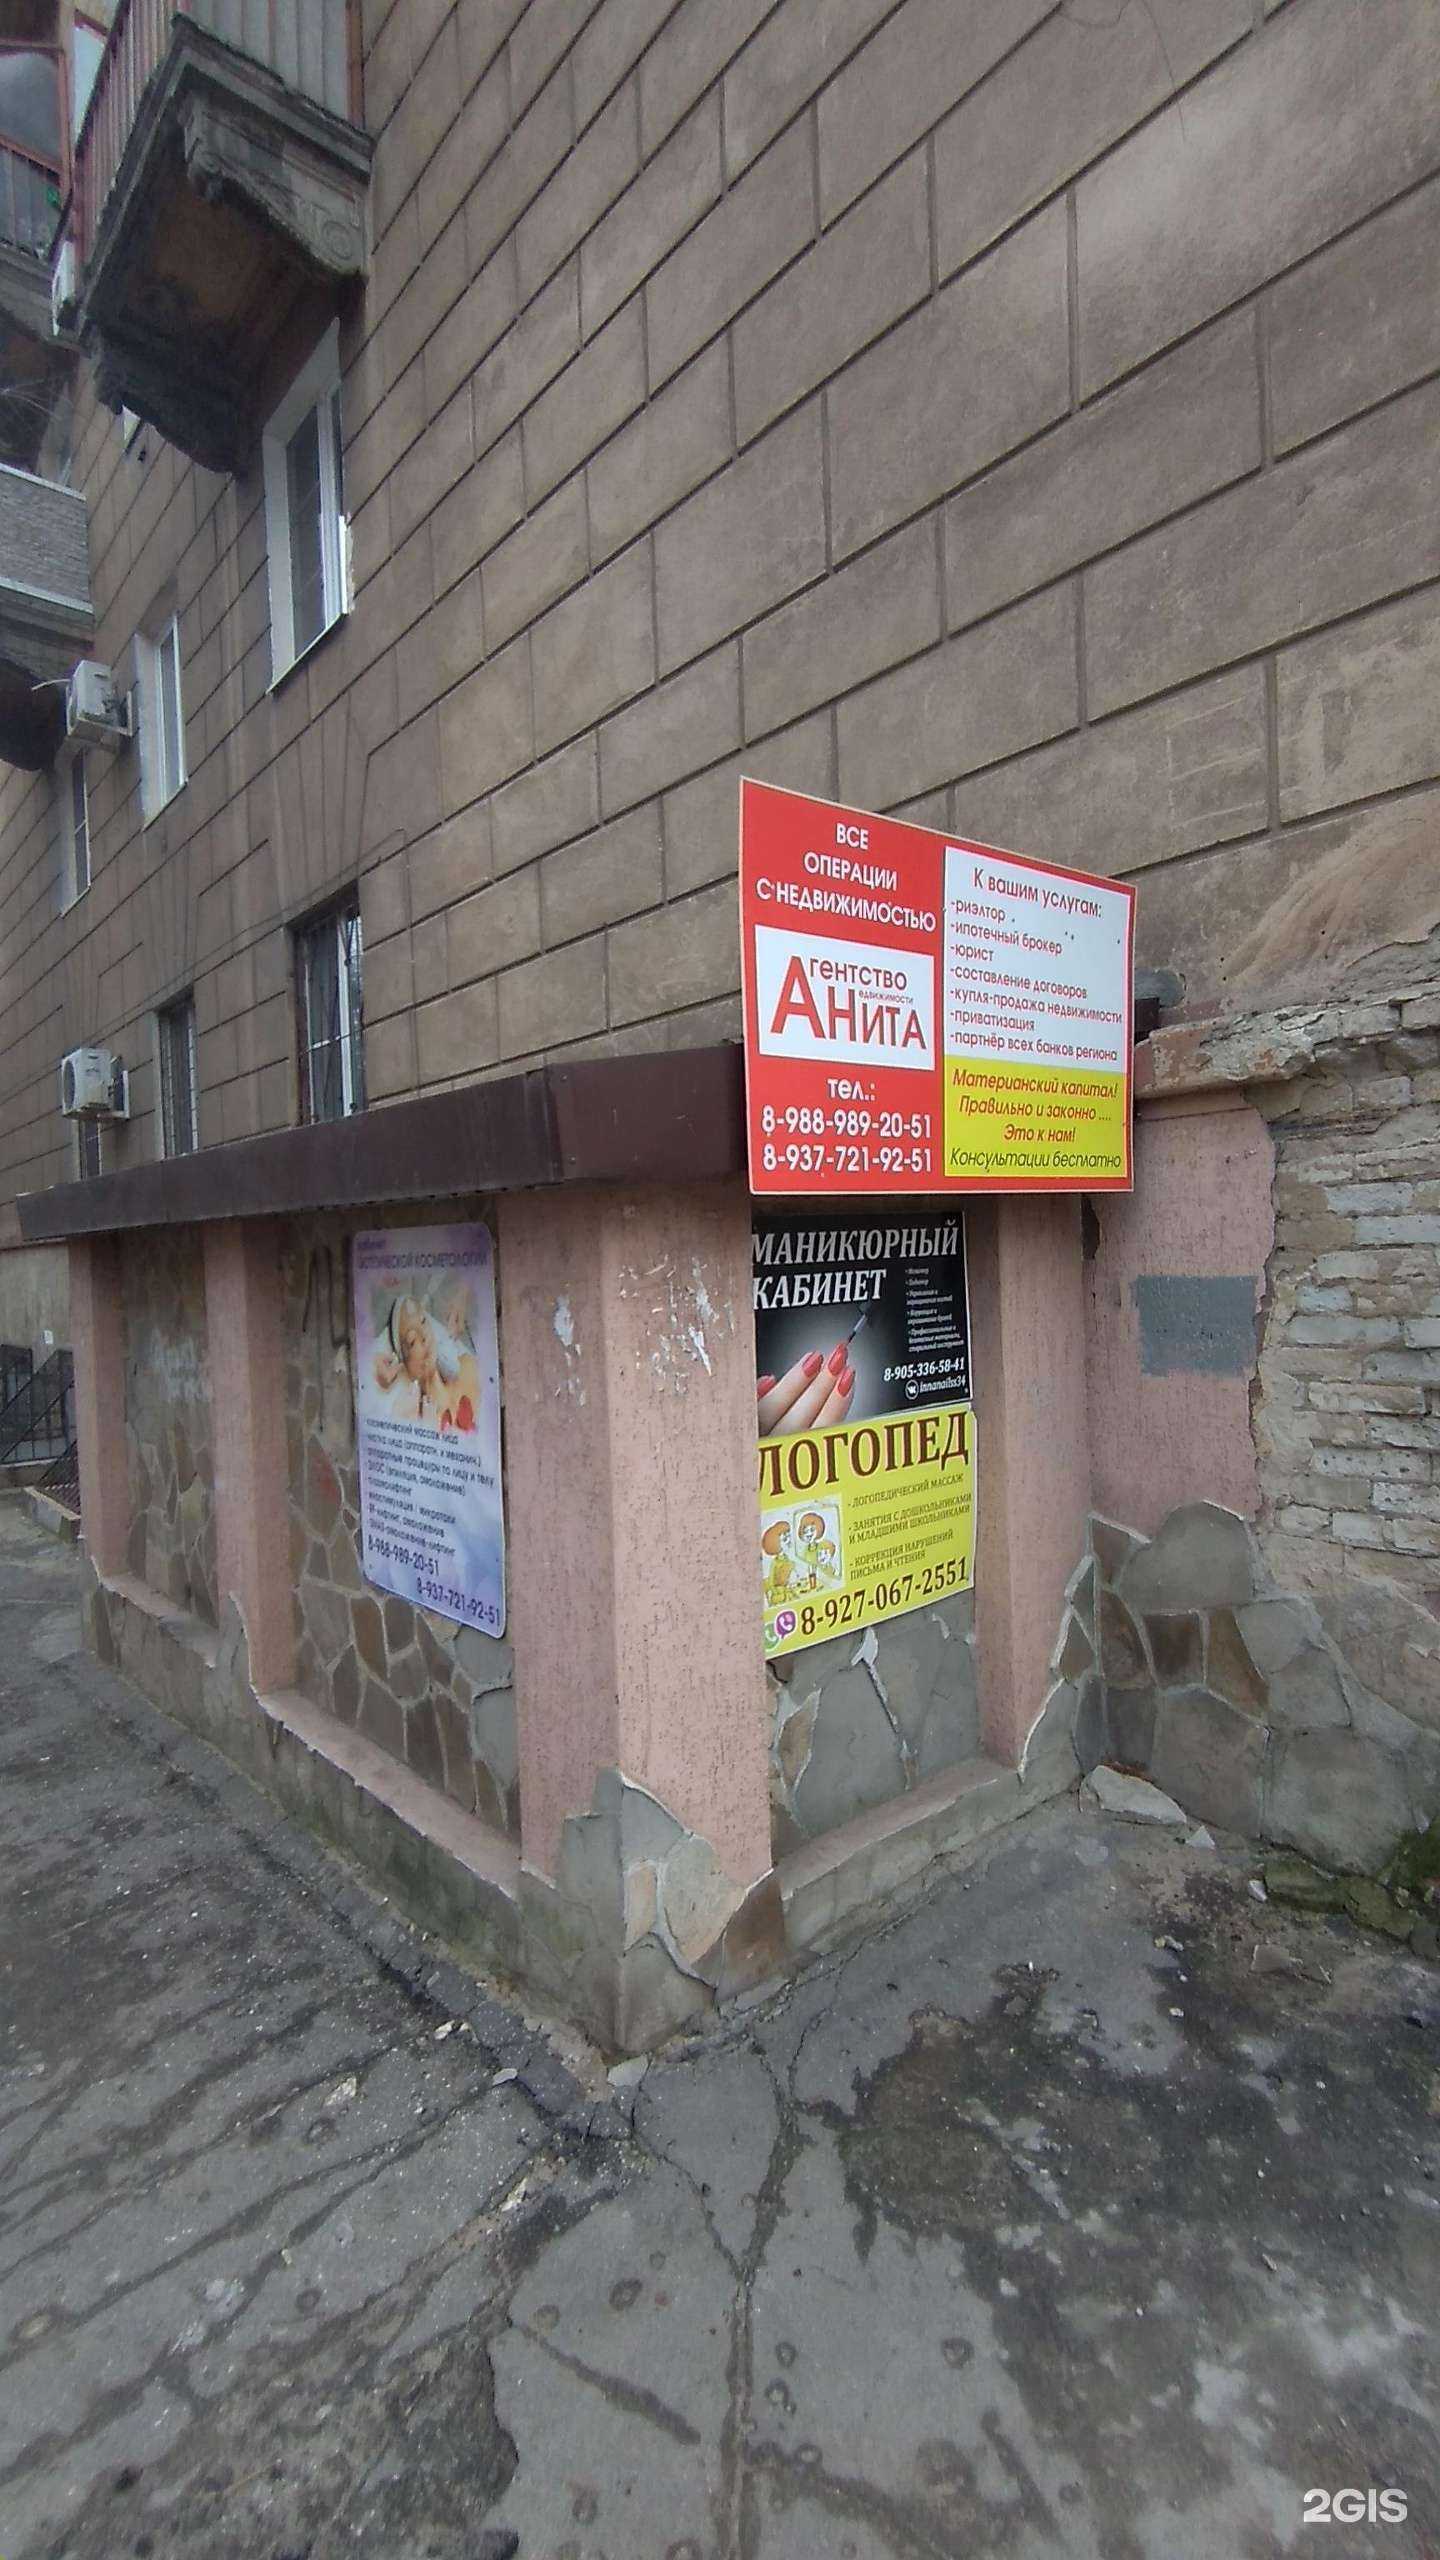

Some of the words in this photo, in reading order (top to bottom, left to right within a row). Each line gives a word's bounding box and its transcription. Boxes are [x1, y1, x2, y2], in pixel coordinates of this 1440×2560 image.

[836, 823, 869, 850] ВСЕ
[804, 851, 897, 891] ОПЕРАЦИИ
[756, 878, 771, 900] С
[776, 881, 936, 932] НЕДВИЖИМОСТЬЮ
[974, 867, 983, 888] К
[988, 876, 1038, 901] вашим
[1042, 889, 1101, 918] услугам:
[1022, 933, 1062, 954] брокер
[1033, 982, 1087, 999] договоров
[1048, 1005, 1122, 1024] недвижимости
[1008, 1039, 1033, 1051] всех
[1036, 1038, 1073, 1056] банков
[1076, 1047, 1117, 1061] региона
[827, 1078, 875, 1100] тел.:
[1061, 1083, 1118, 1098] капитал!
[762, 1105, 931, 1138] 8-988-989-20-51
[959, 1095, 1033, 1116] Правильно
[1036, 1105, 1044, 1117] и
[1046, 1105, 1096, 1120] законно
[1004, 1124, 1034, 1141] Это
[1037, 1129, 1044, 1141] к
[1048, 1127, 1076, 1143] нам!
[763, 1143, 931, 1172] 8-937-721-92-51
[950, 1147, 1050, 1169] Консультации
[1052, 1151, 1121, 1168] бесплатно
[751, 1219, 960, 1266] МАНИКЮРНЫЙ
[753, 1269, 887, 1311] КАБИНЕТ
[883, 1357, 965, 1382] 8-905-336-58-41
[758, 1411, 969, 1497] ЛОГОПЕД
[852, 1480, 929, 1508] ЛОГОПЕДИЧЕСКИЙ
[931, 1473, 964, 1488] МАССАЖ
[849, 1535, 855, 1545] И
[857, 1521, 909, 1543] МЛАДШИМИ
[910, 1505, 970, 1528] ШКОЛЬНИКАМИ
[854, 1513, 891, 1531] ЗАНЯТИЯ
[893, 1511, 899, 1520] С
[900, 1492, 972, 1520] ДОШКОЛЬНИКАМИ
[855, 1544, 903, 1567] КОРРЕКЦИЯ
[905, 1528, 953, 1553] НАРУШЕНИЙ
[850, 1563, 885, 1580] ПИСЬМА
[887, 1559, 893, 1569] И
[894, 1550, 926, 1568] ЧТЕНИЯ
[417, 1577, 500, 1626] 8-937-721-92-51
[800, 1556, 967, 1635] 8-927-067-2551
